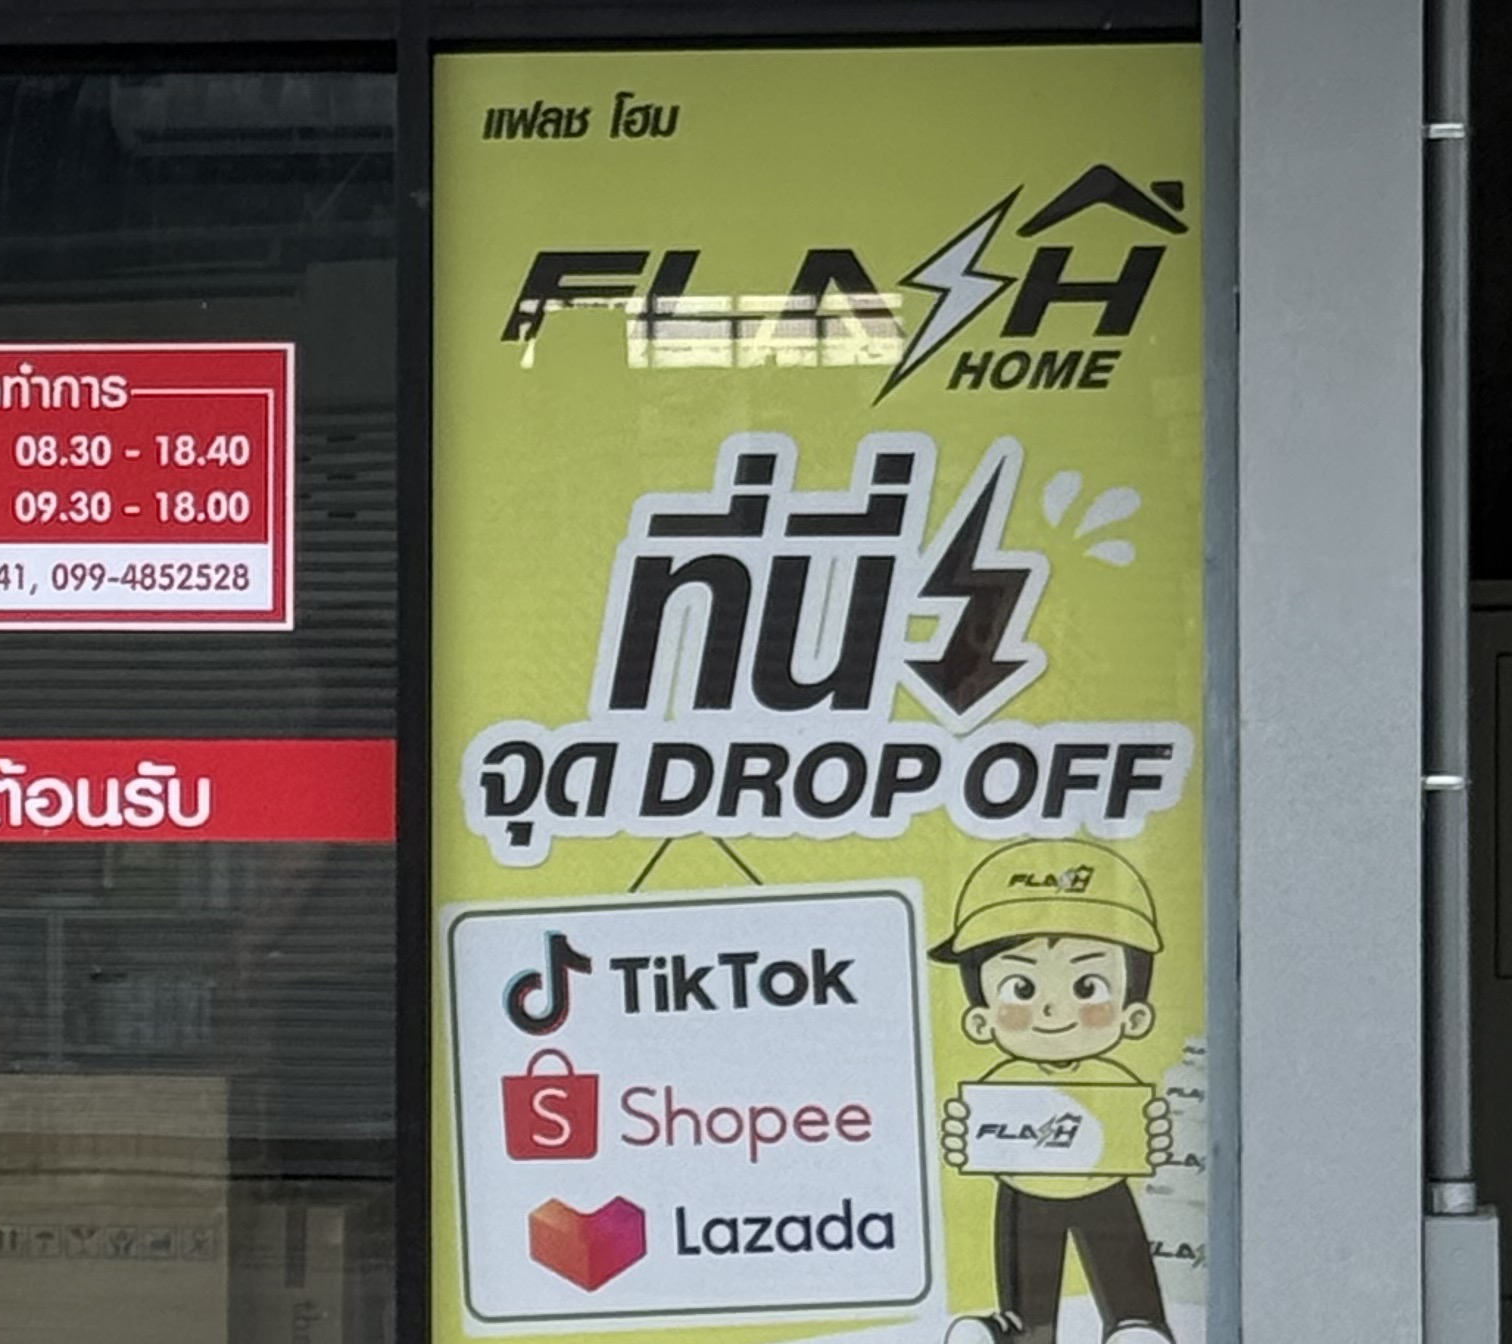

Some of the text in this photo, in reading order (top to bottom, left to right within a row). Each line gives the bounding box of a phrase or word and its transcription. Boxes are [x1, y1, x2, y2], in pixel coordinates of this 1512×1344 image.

[482, 91, 680, 141] แฟลช โฮม
[946, 350, 1122, 391] HOME
[14, 436, 112, 468] 08.30
[155, 435, 250, 467] 18.40
[14, 492, 112, 523] 09.30
[155, 491, 250, 523] 18.00
[51, 563, 250, 592] 099-4852528
[608, 452, 917, 710] ที่นี่
[480, 740, 1174, 848] จุด DROP OFF
[609, 948, 858, 1015] TikTok
[619, 1086, 873, 1163] Shopee
[675, 1197, 896, 1257] Lazada
